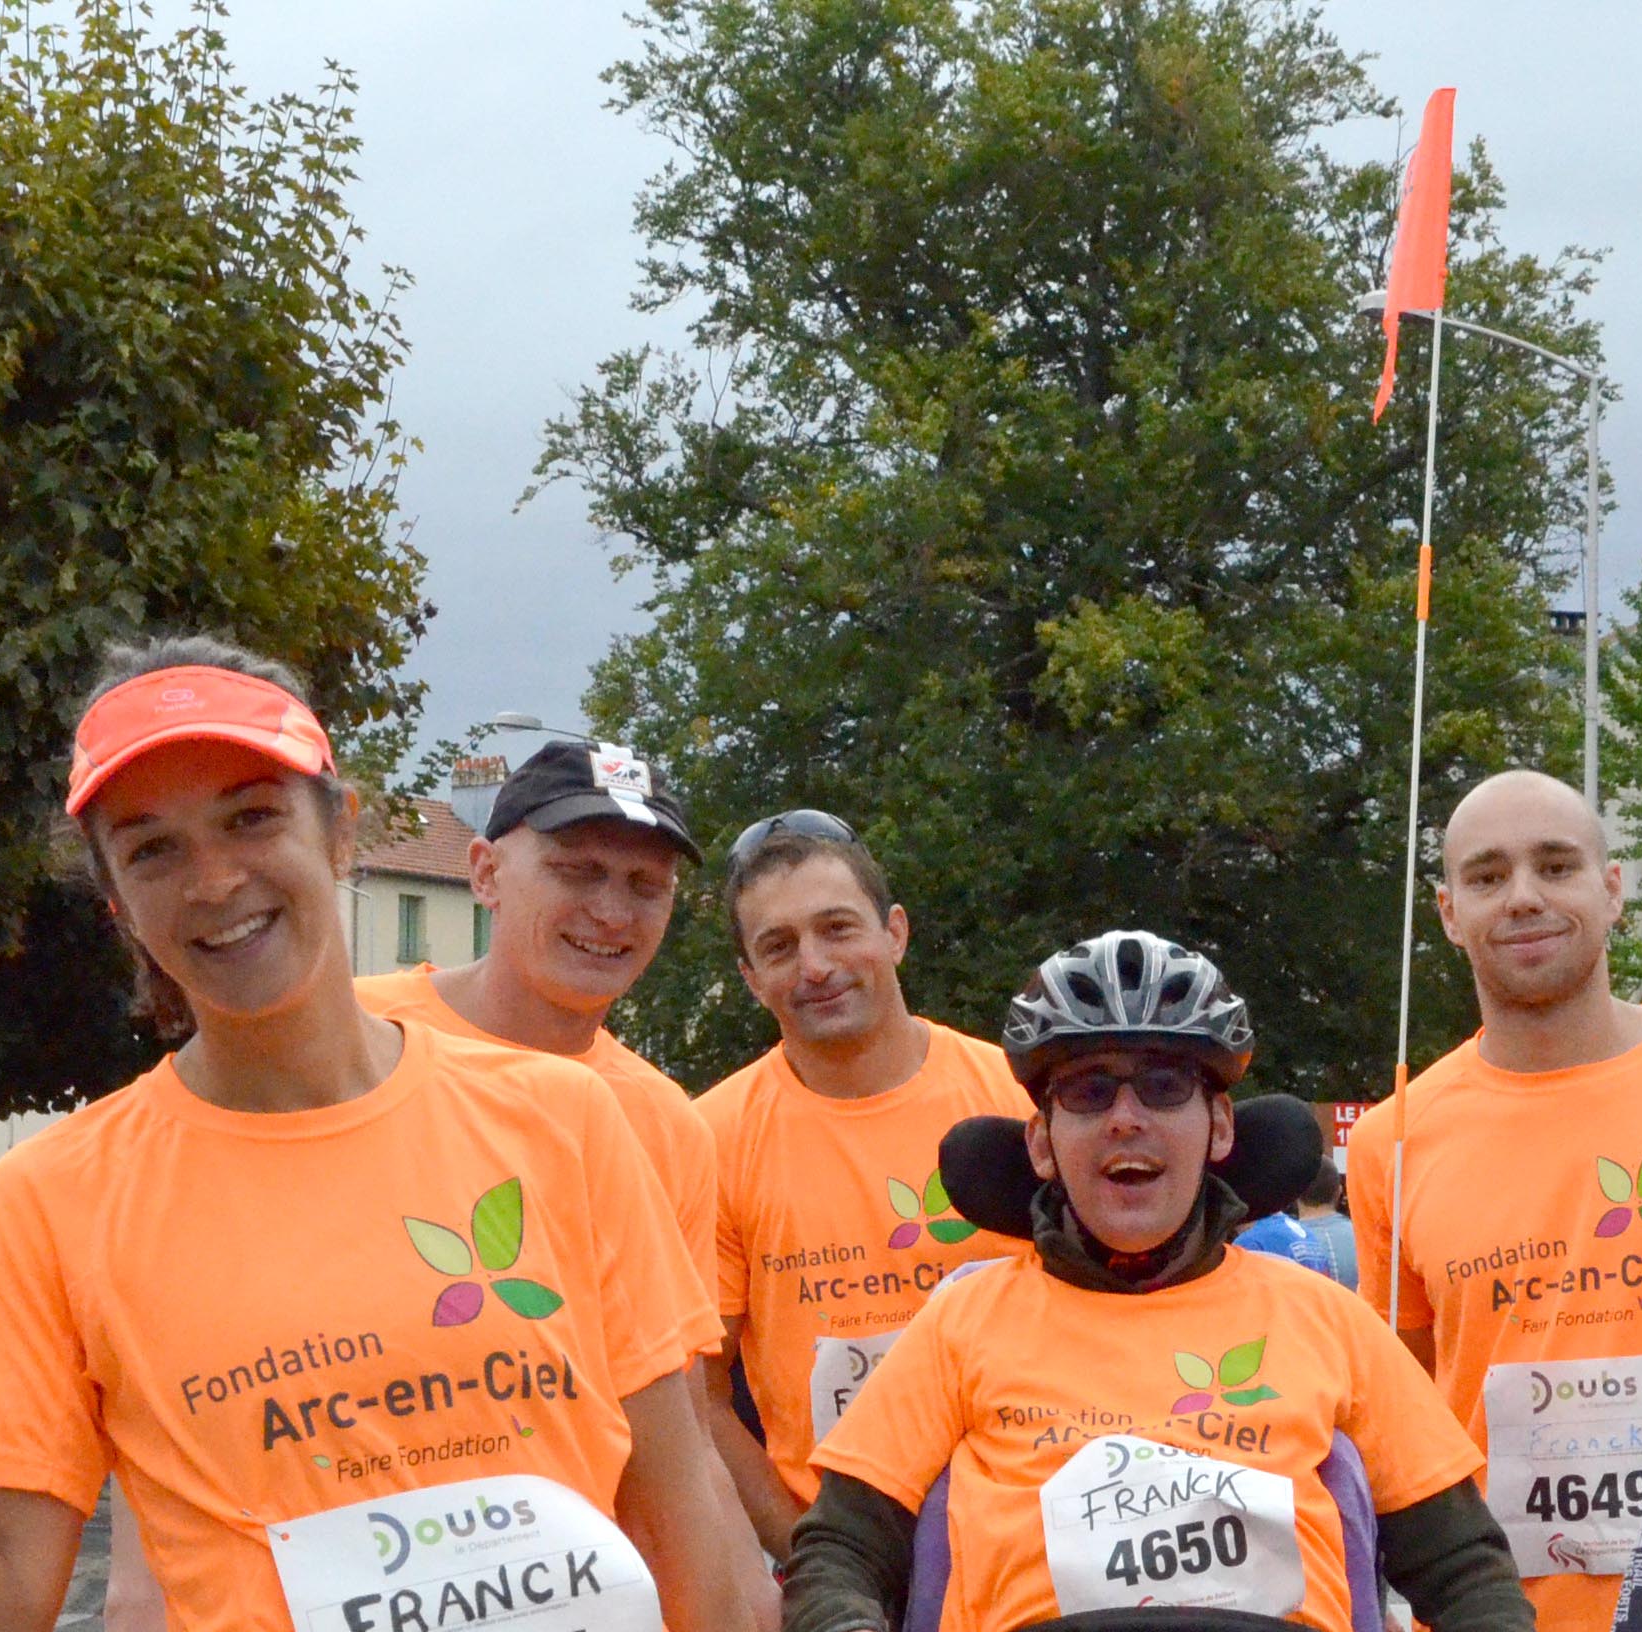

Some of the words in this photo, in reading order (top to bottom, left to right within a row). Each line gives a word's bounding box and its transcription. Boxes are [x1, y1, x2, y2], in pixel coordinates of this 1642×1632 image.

[1335, 1105, 1356, 1123] LE
[761, 1243, 866, 1275] Fondation
[1446, 1237, 1568, 1285] Fondation
[798, 1262, 955, 1305] Arc-en-Ci
[830, 1314, 862, 1329] Faire
[1556, 1309, 1635, 1328] Fondation
[180, 1332, 384, 1415] Fondation
[1530, 1370, 1637, 1415] Doubs
[262, 1349, 579, 1451] Arc-en-Ciel
[336, 1450, 393, 1483] Faire
[398, 1432, 510, 1469] Fondation
[1081, 1466, 1249, 1531] FRANCK
[367, 1495, 537, 1577] Doubs
[1105, 1514, 1248, 1587] 4650
